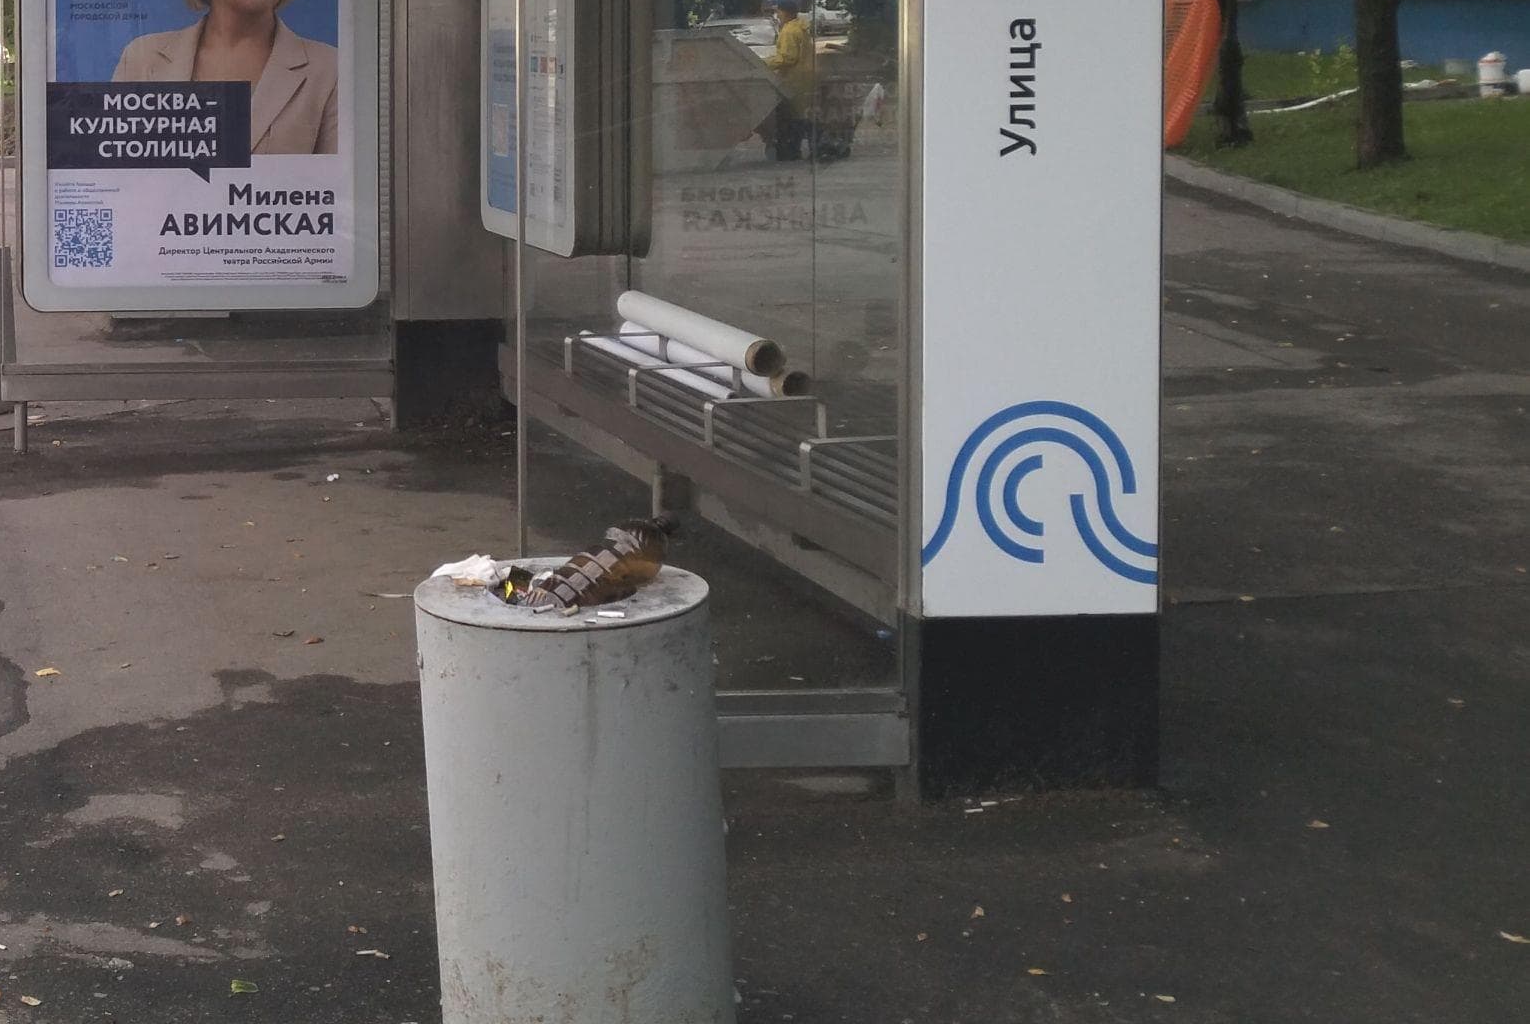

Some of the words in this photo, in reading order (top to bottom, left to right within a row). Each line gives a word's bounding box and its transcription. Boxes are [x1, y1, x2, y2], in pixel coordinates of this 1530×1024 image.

[999, 18, 1042, 157] Улица
[103, 93, 202, 111] МОСКВА
[70, 116, 217, 134] КУЛЬТУРНАЯ
[98, 139, 218, 159] СТОЛИЦА!
[228, 183, 335, 206] Милена
[159, 212, 334, 236] АВИМСКАЯ
[158, 247, 201, 256] Директор
[203, 247, 263, 255] Центрального
[223, 258, 251, 266] театра
